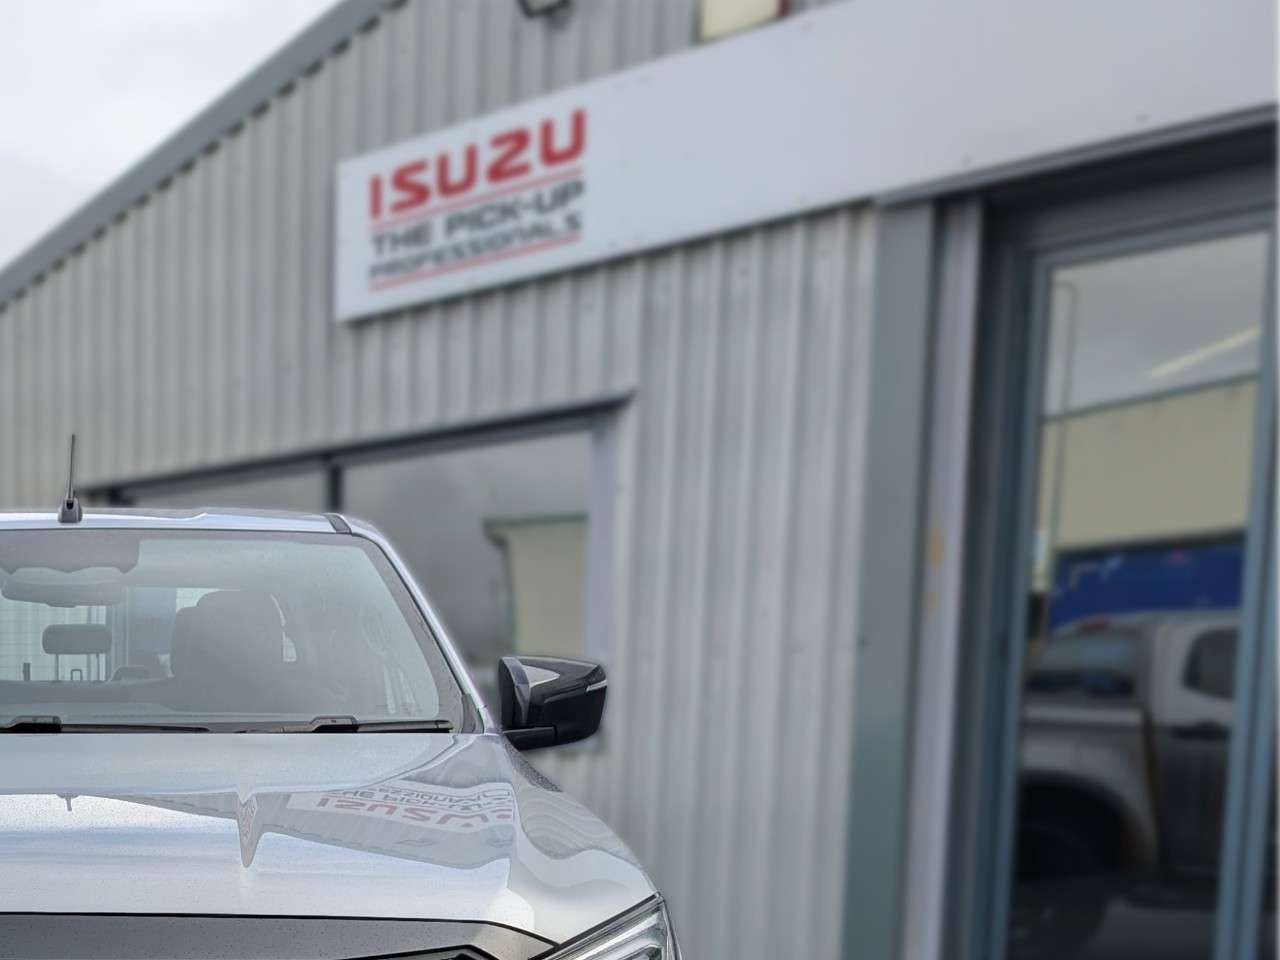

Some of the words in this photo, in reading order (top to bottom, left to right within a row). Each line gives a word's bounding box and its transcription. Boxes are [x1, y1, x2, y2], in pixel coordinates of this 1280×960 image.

[369, 108, 586, 220] ISUZU
[370, 210, 582, 279] PROFESSIONALS
[371, 224, 431, 255] THE
[443, 179, 585, 238] PICK-UP
